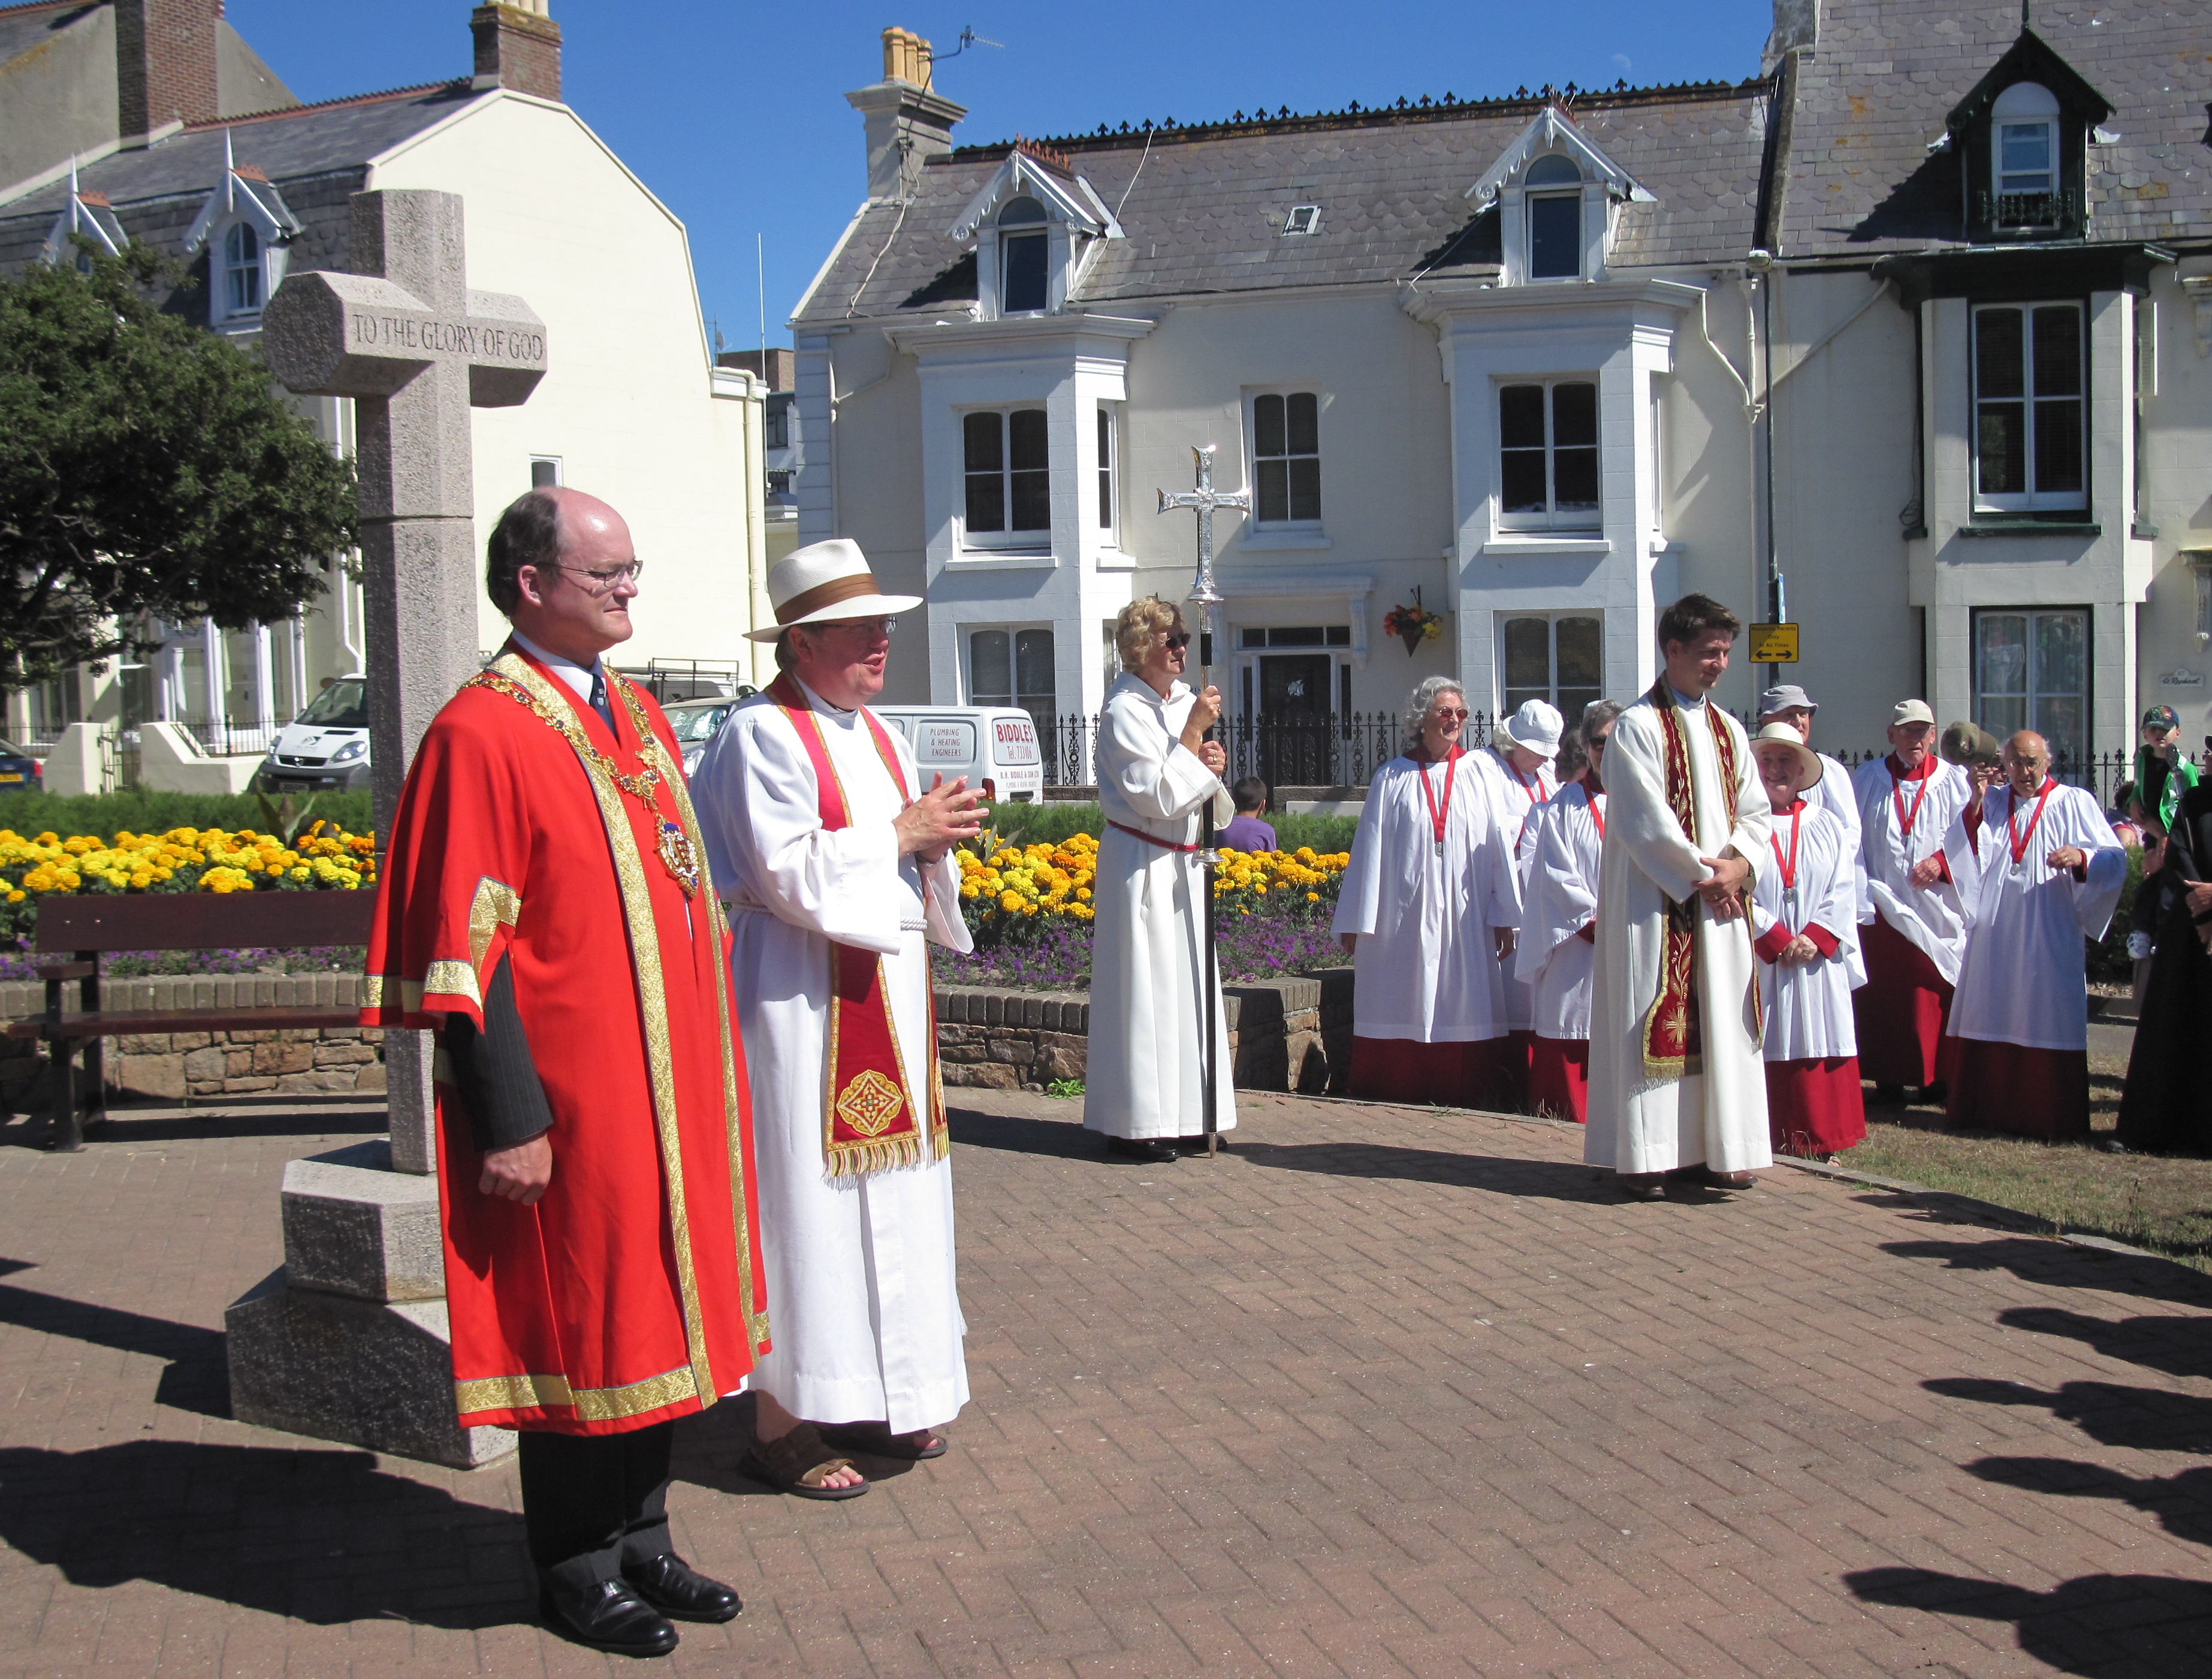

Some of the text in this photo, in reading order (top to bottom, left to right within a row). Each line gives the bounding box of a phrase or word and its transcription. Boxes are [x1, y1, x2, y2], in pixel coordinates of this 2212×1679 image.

[352, 314, 543, 361] TO THE GLORY OF GOD
[996, 724, 1034, 743] BIDDLES
[932, 748, 961, 756] ENGINEERS
[1007, 746, 1016, 759] Tel.
[1010, 771, 1024, 779] BIDDLE
